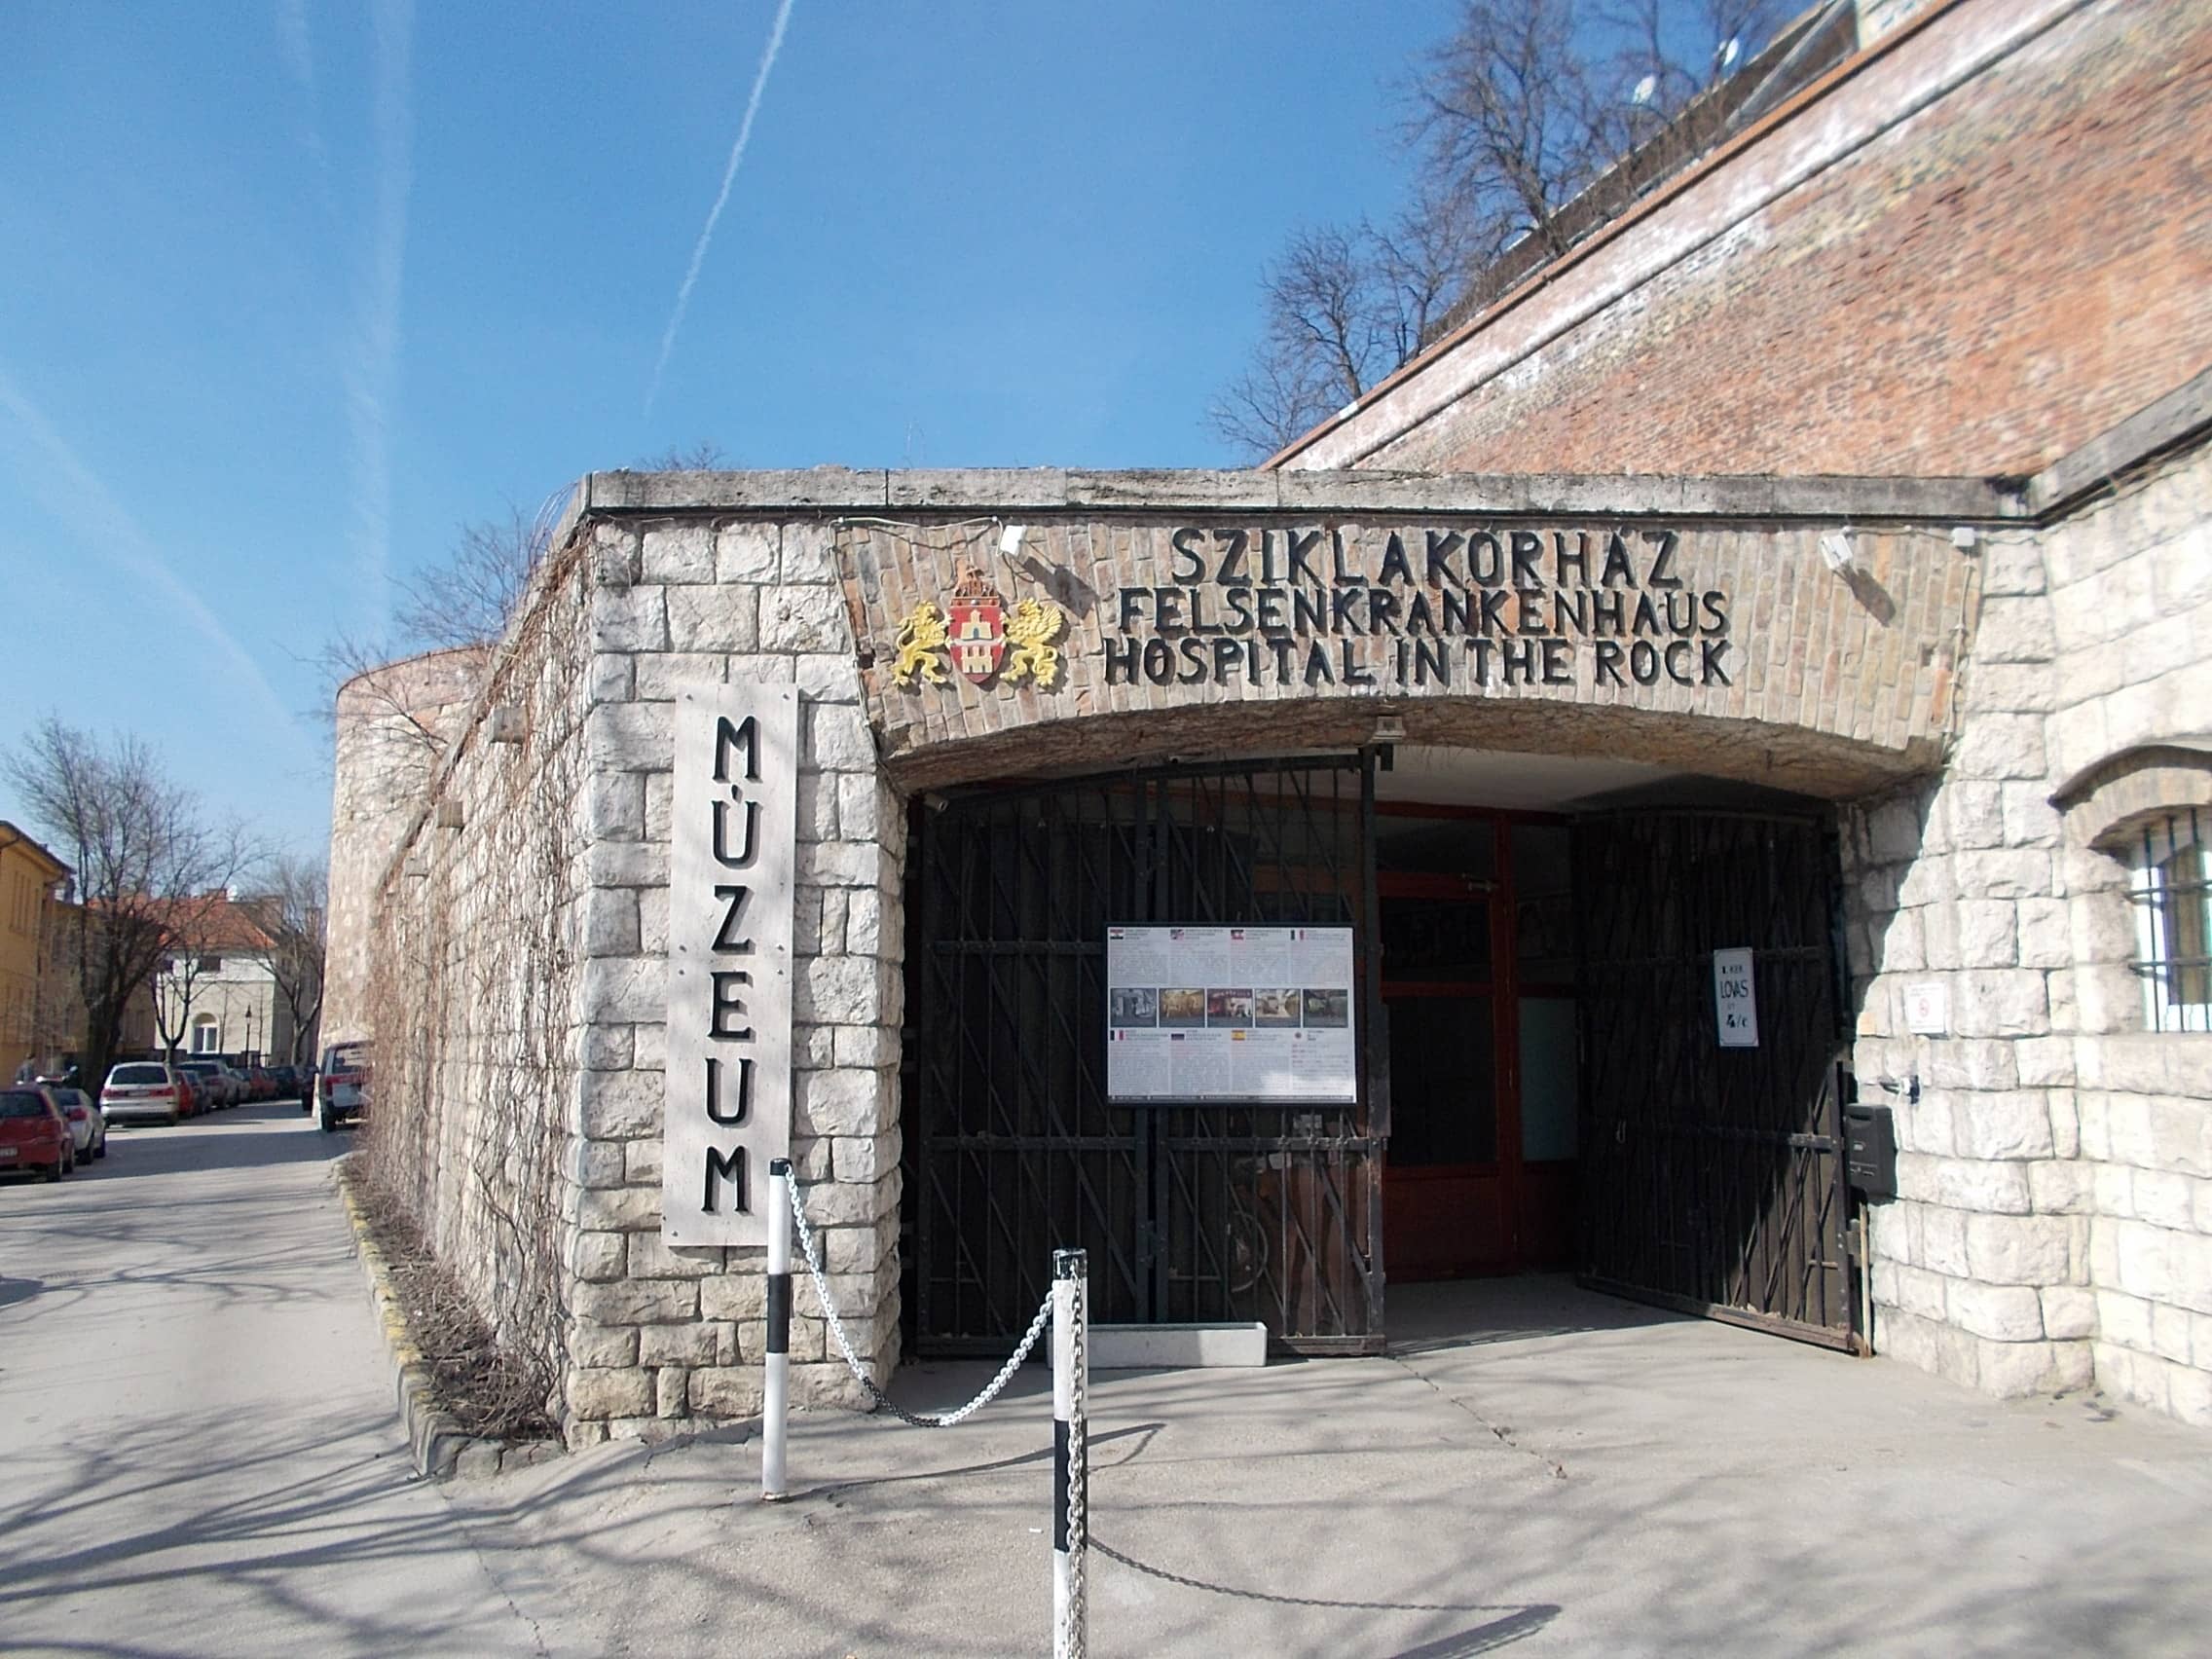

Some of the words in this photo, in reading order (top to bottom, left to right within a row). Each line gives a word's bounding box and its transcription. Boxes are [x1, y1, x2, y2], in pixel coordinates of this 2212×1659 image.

[1118, 585, 1728, 639] FELSENKRANKENHAUS
[1104, 637, 1373, 685] HOSPITAL
[1394, 638, 1451, 685] IN
[1465, 639, 1576, 685] THE
[1594, 639, 1734, 687] ROCK
